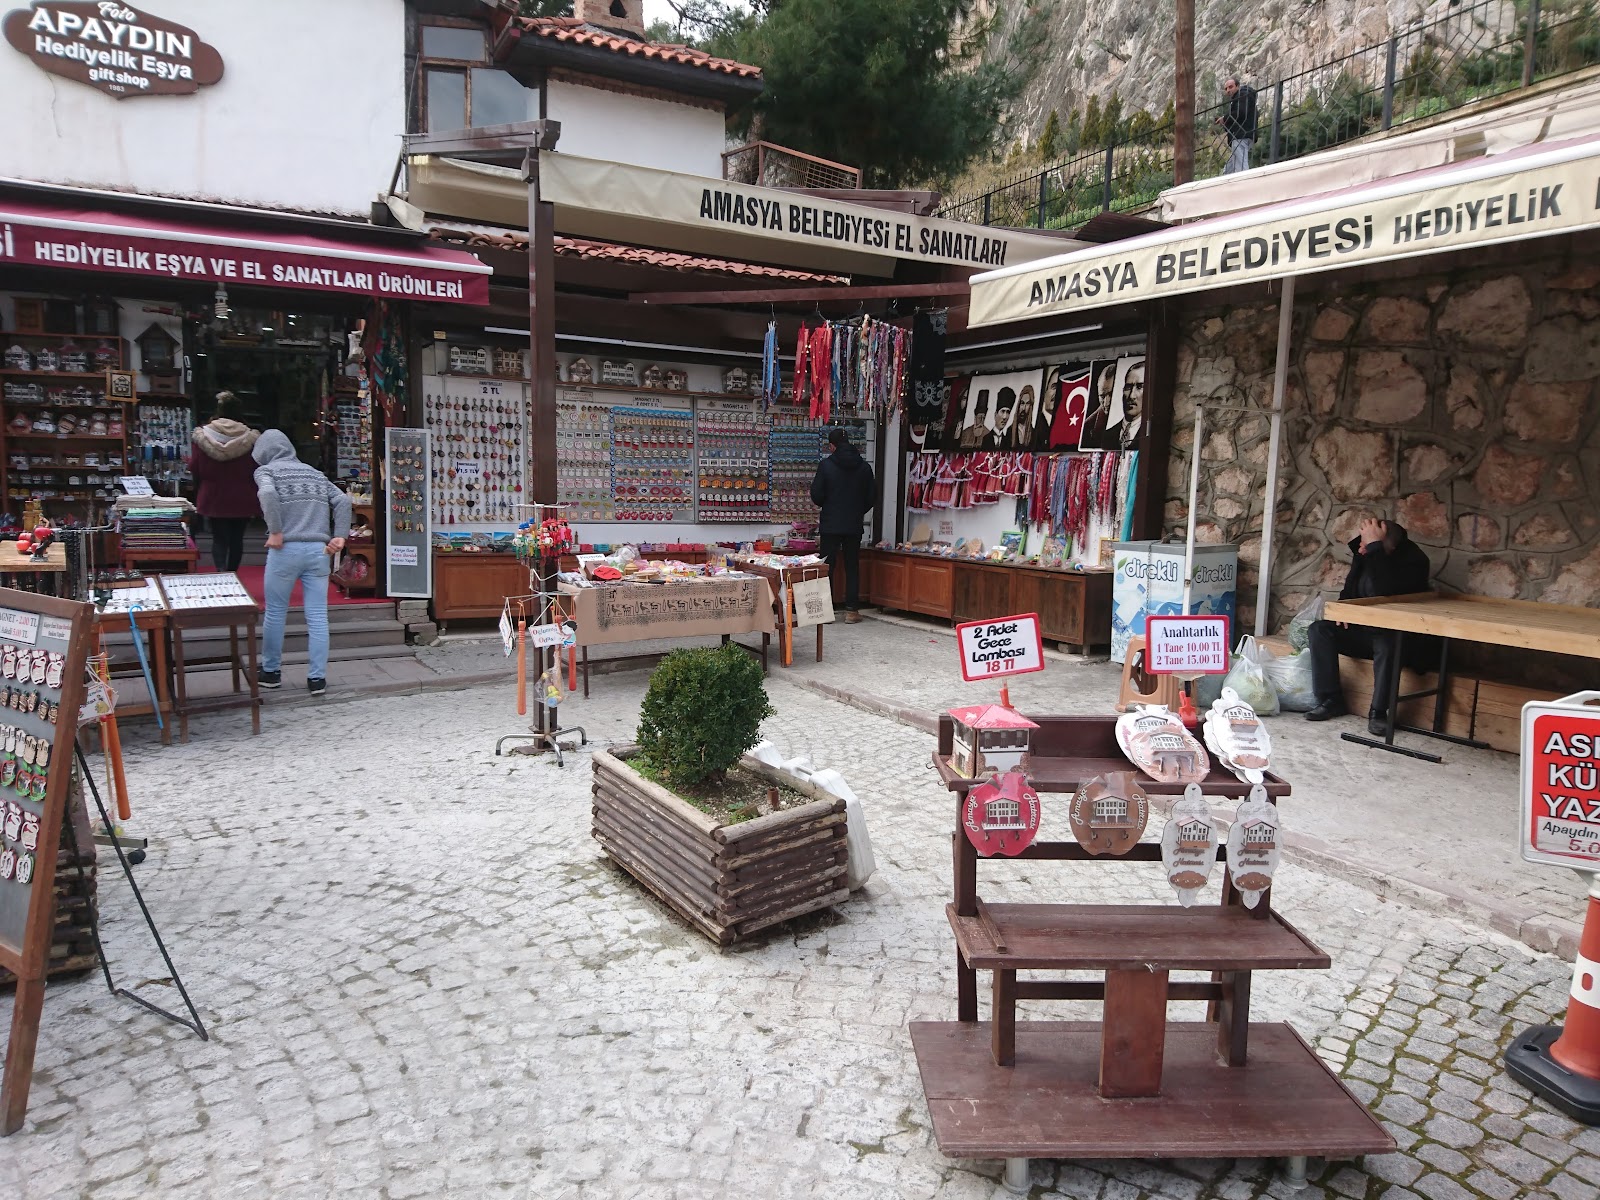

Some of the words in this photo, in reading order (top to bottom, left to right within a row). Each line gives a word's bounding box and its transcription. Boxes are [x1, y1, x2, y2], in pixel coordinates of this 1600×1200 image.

[98, 1, 137, 22] Foto
[28, 7, 192, 59] APAYDIN
[35, 34, 138, 69] Hediyelik
[142, 54, 193, 80] Eşya
[89, 67, 114, 82] gift
[116, 72, 149, 89] shop
[700, 189, 783, 231] AMASYA
[895, 223, 914, 253] EL
[919, 228, 1007, 266] SANATLARI
[35, 241, 151, 269] HEDİYELİK
[155, 253, 206, 276] EŞYA
[210, 258, 237, 277] VE
[242, 261, 266, 280] EL
[272, 264, 373, 290] SANATLARI
[379, 272, 463, 298] ÜRÜNLERİ
[1027, 261, 1138, 308] AMASYA
[482, 386, 488, 394] 2
[490, 387, 500, 395] TL
[1125, 557, 1178, 582] direkli
[1195, 563, 1233, 583] direkli
[30, 617, 37, 628] TL
[973, 627, 982, 638] 2
[987, 623, 1018, 637] Adet
[1161, 625, 1219, 638] Anahtarlık
[22, 629, 28, 639] TL
[978, 638, 1012, 649] Gece
[1157, 643, 1161, 652] 1
[1164, 643, 1184, 652] Tane
[1187, 642, 1209, 652] 10.00
[1212, 641, 1222, 652] TL
[972, 648, 1025, 662] Lambası
[1157, 655, 1162, 665] 2
[1164, 655, 1184, 665] Tane
[1187, 654, 1209, 664] 15.00
[1212, 654, 1222, 664] TL
[986, 660, 1000, 672] 18
[966, 795, 979, 832] Amasya
[1070, 788, 1087, 826] Amasya
[1543, 822, 1598, 839] Apaydın
